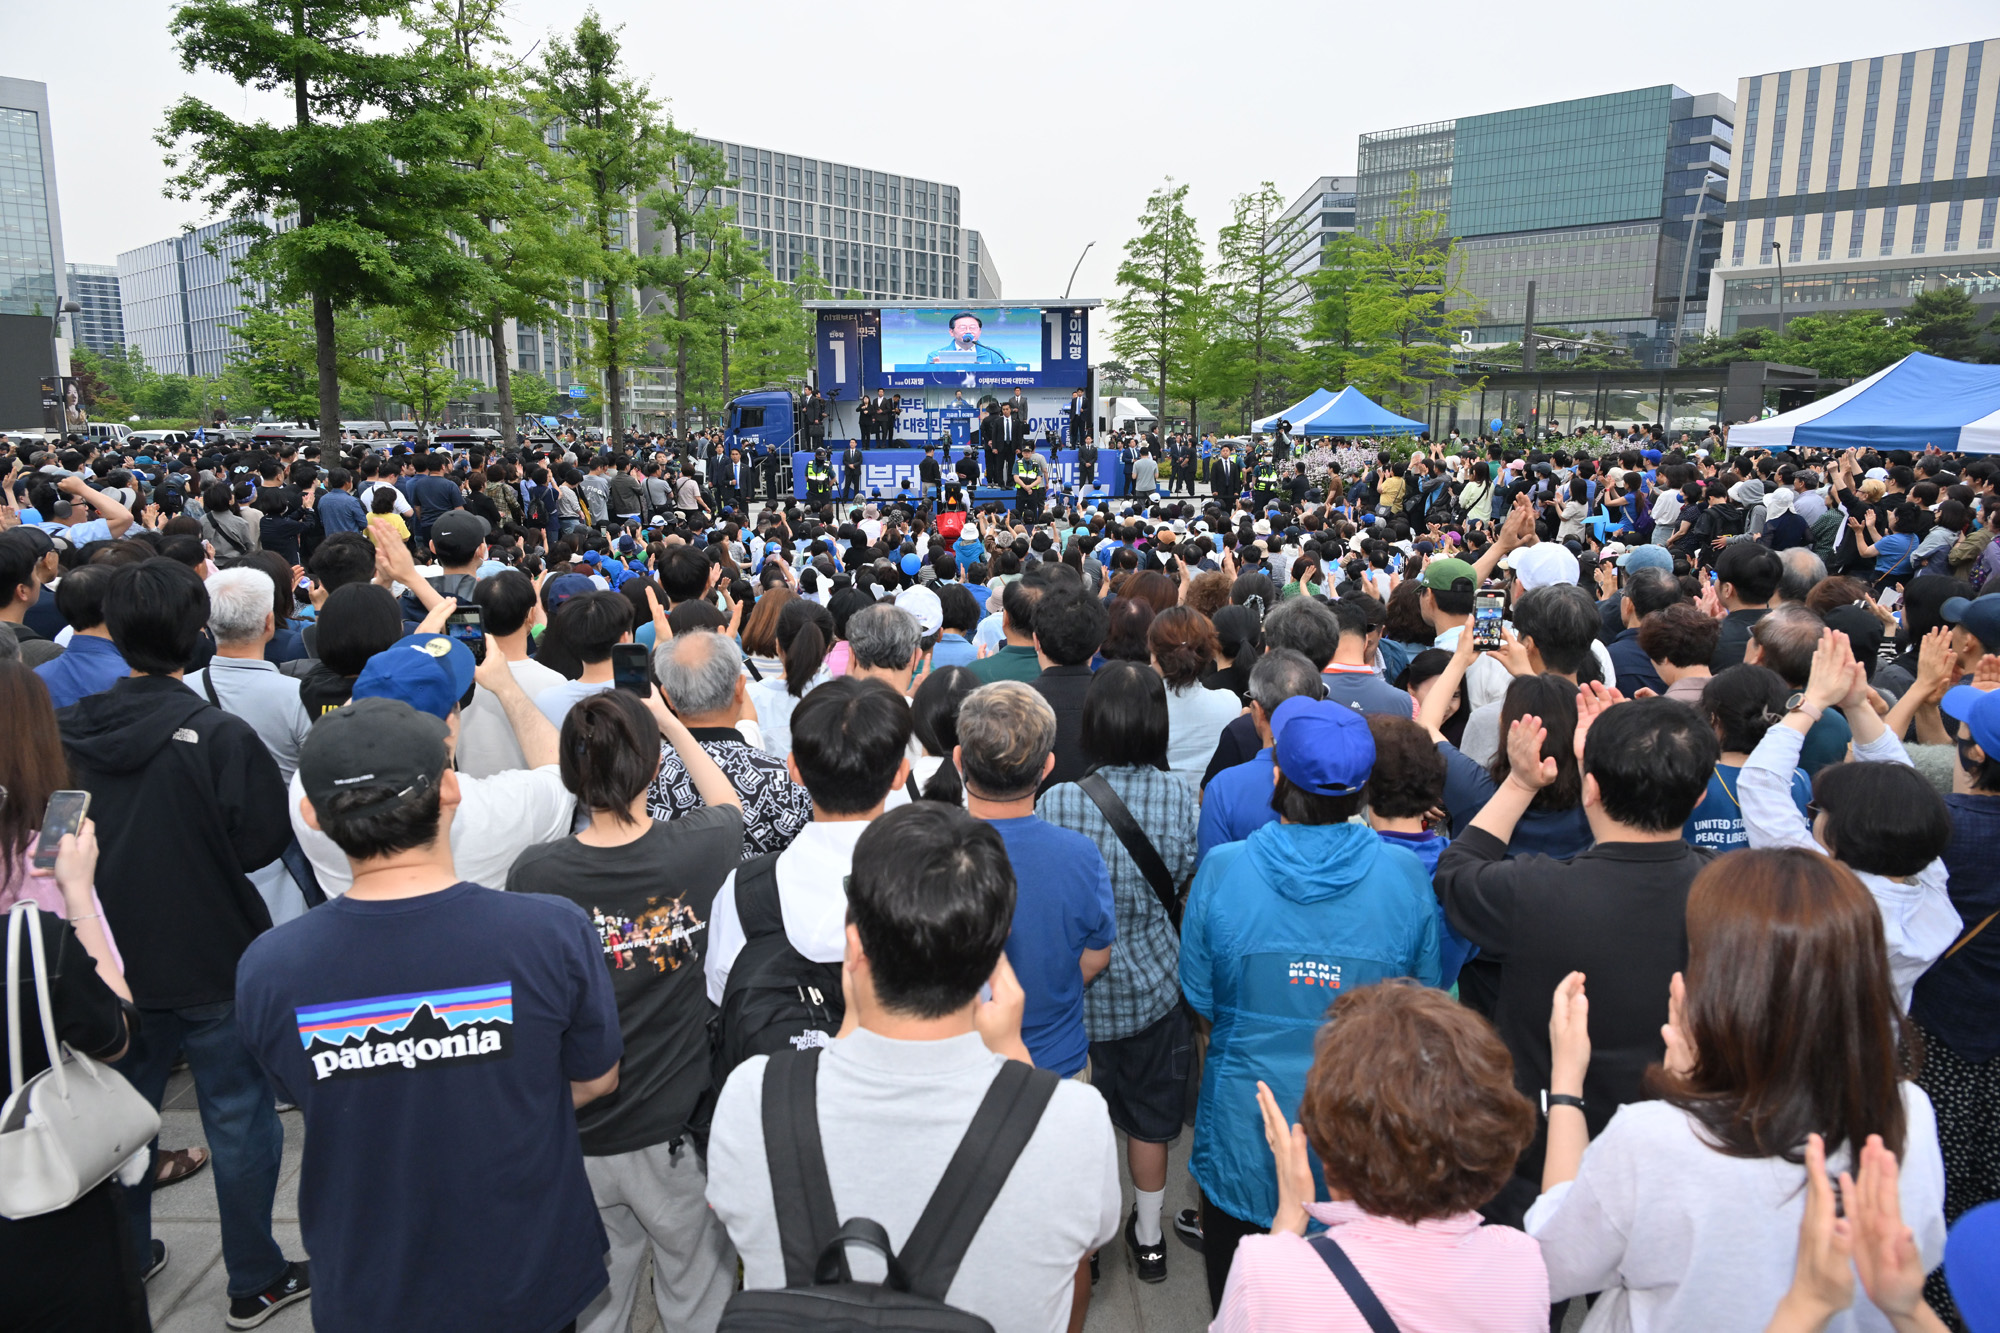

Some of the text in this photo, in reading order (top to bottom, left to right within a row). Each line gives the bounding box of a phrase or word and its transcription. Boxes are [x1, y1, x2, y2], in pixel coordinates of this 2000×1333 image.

[857, 326, 877, 337] 민국
[1045, 312, 1062, 360] 1
[1069, 318, 1082, 360] 이재명
[829, 340, 846, 384] 1
[887, 374, 892, 386] 1
[904, 378, 925, 386] 이재명
[978, 377, 1001, 385] 이제부터
[1012, 377, 1035, 385] 대한민국
[957, 410, 962, 418] 1
[957, 425, 963, 438] 1
[733, 434, 738, 445] 1
[1694, 819, 1730, 831] UNITED
[1695, 832, 1724, 843] PEACE
[1289, 969, 1341, 981] BLANC
[311, 1027, 502, 1080] patagonia
